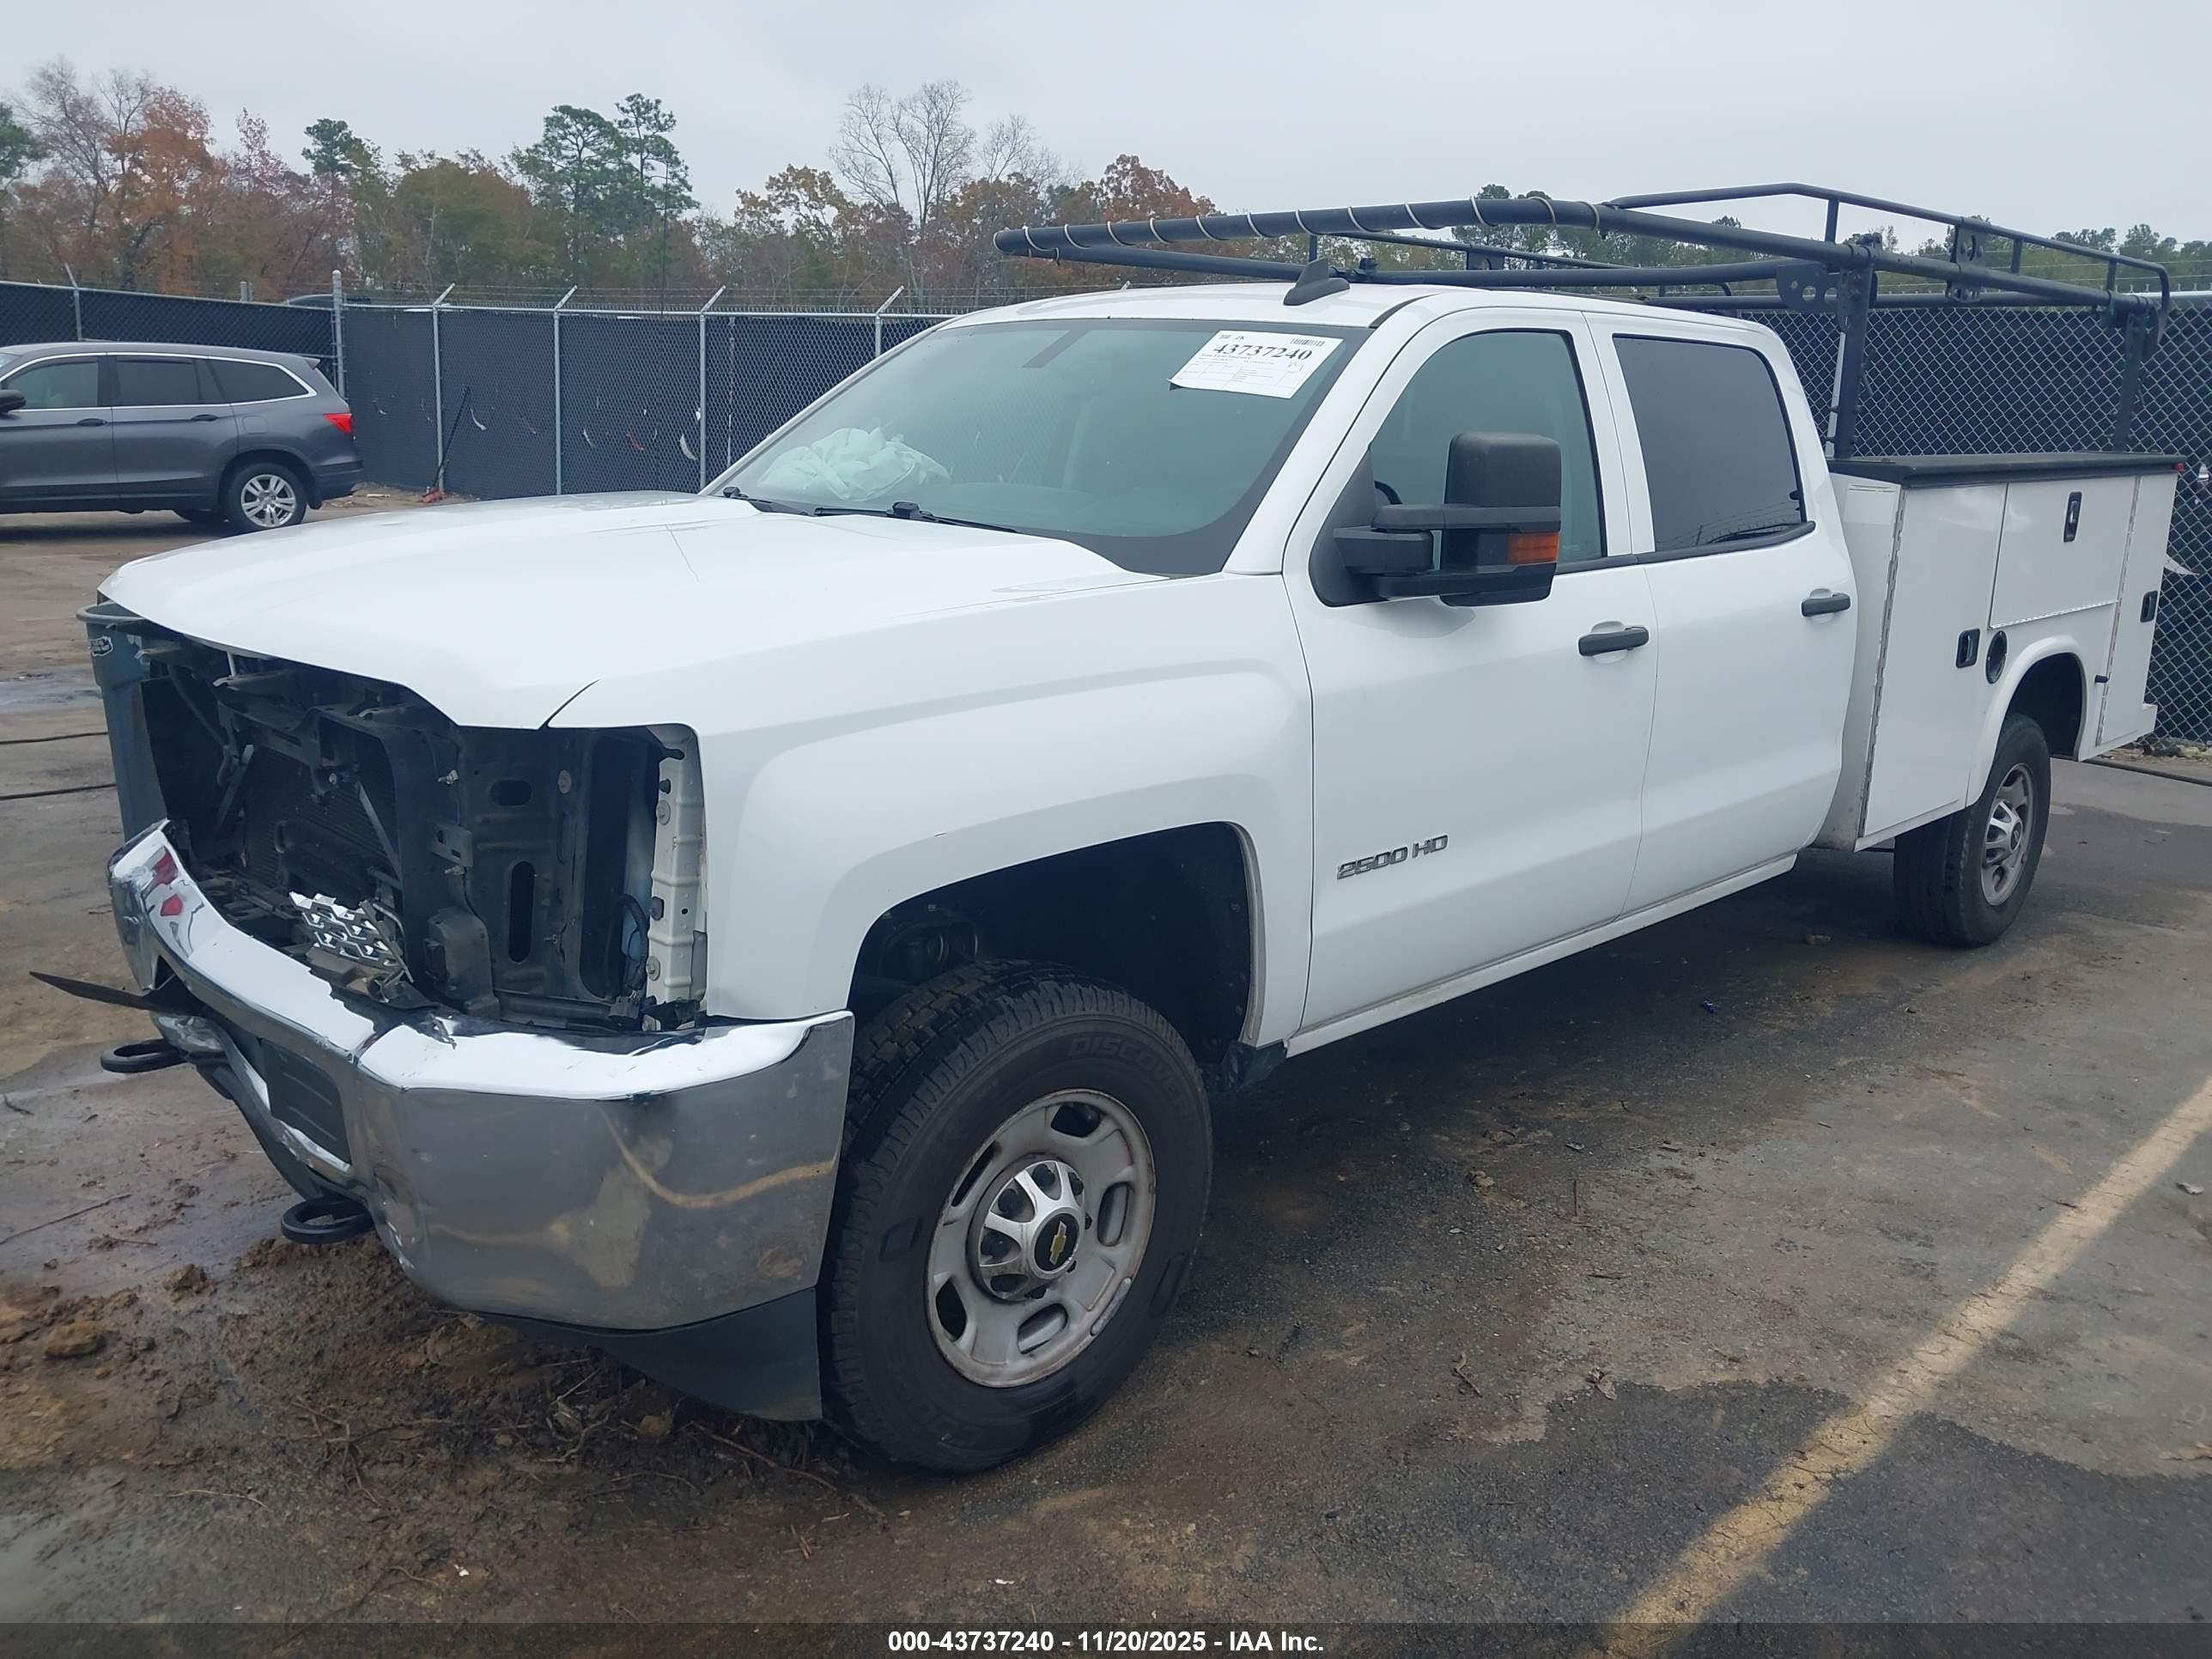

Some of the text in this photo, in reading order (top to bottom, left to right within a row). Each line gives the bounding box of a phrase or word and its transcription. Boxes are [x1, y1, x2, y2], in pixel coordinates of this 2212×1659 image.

[1214, 343, 1312, 361] 43737240
[1337, 834, 1449, 880] 2500 HD
